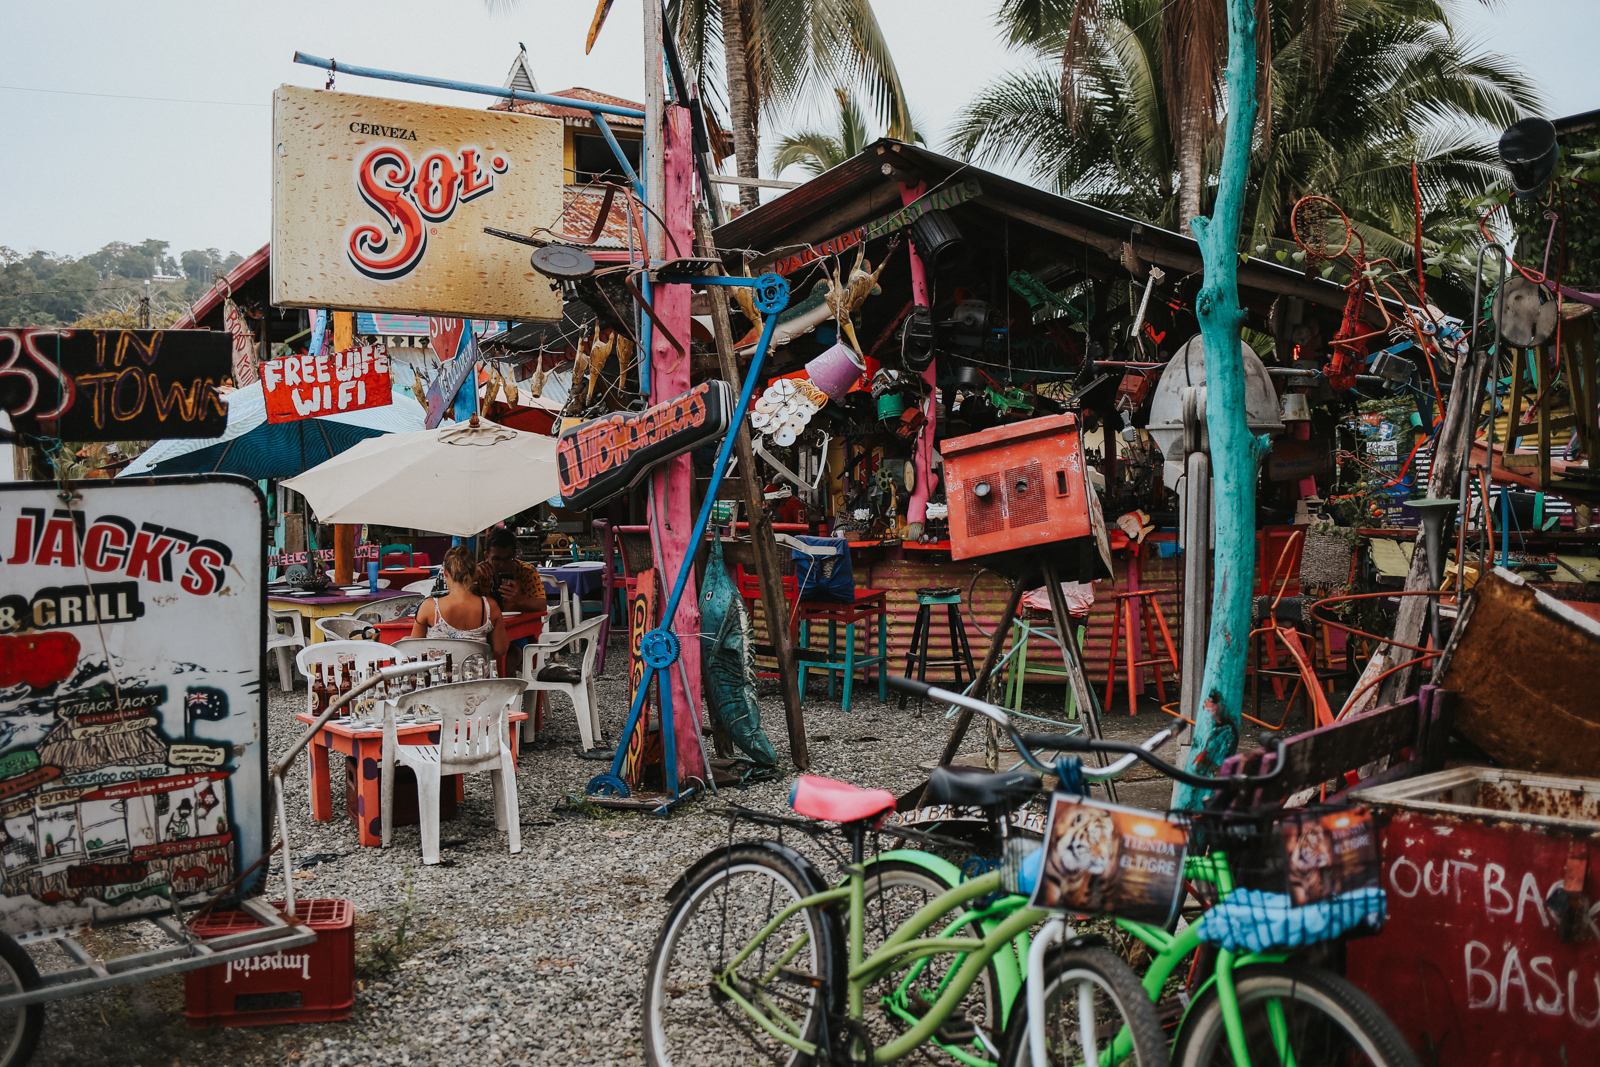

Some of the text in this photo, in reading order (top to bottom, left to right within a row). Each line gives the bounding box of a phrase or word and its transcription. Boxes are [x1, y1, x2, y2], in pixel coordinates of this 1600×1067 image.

[349, 121, 418, 142] CERVEZA
[347, 147, 494, 280] SOL
[866, 178, 979, 241] MARTINIS
[93, 329, 164, 367] IN
[226, 309, 247, 352] ROAD
[264, 355, 302, 393] FREE
[75, 366, 229, 430] TOWN
[291, 380, 367, 416] WIFI
[7, 507, 233, 596] JACK'S
[32, 592, 134, 626] GRILL
[40, 786, 85, 804] SYDNEY
[104, 789, 131, 798] Rather
[157, 781, 175, 790] Butt
[178, 842, 193, 851] the
[1123, 833, 1176, 857] TIENDA
[1133, 855, 1176, 877] TIGRE
[225, 951, 312, 984] Imperial
